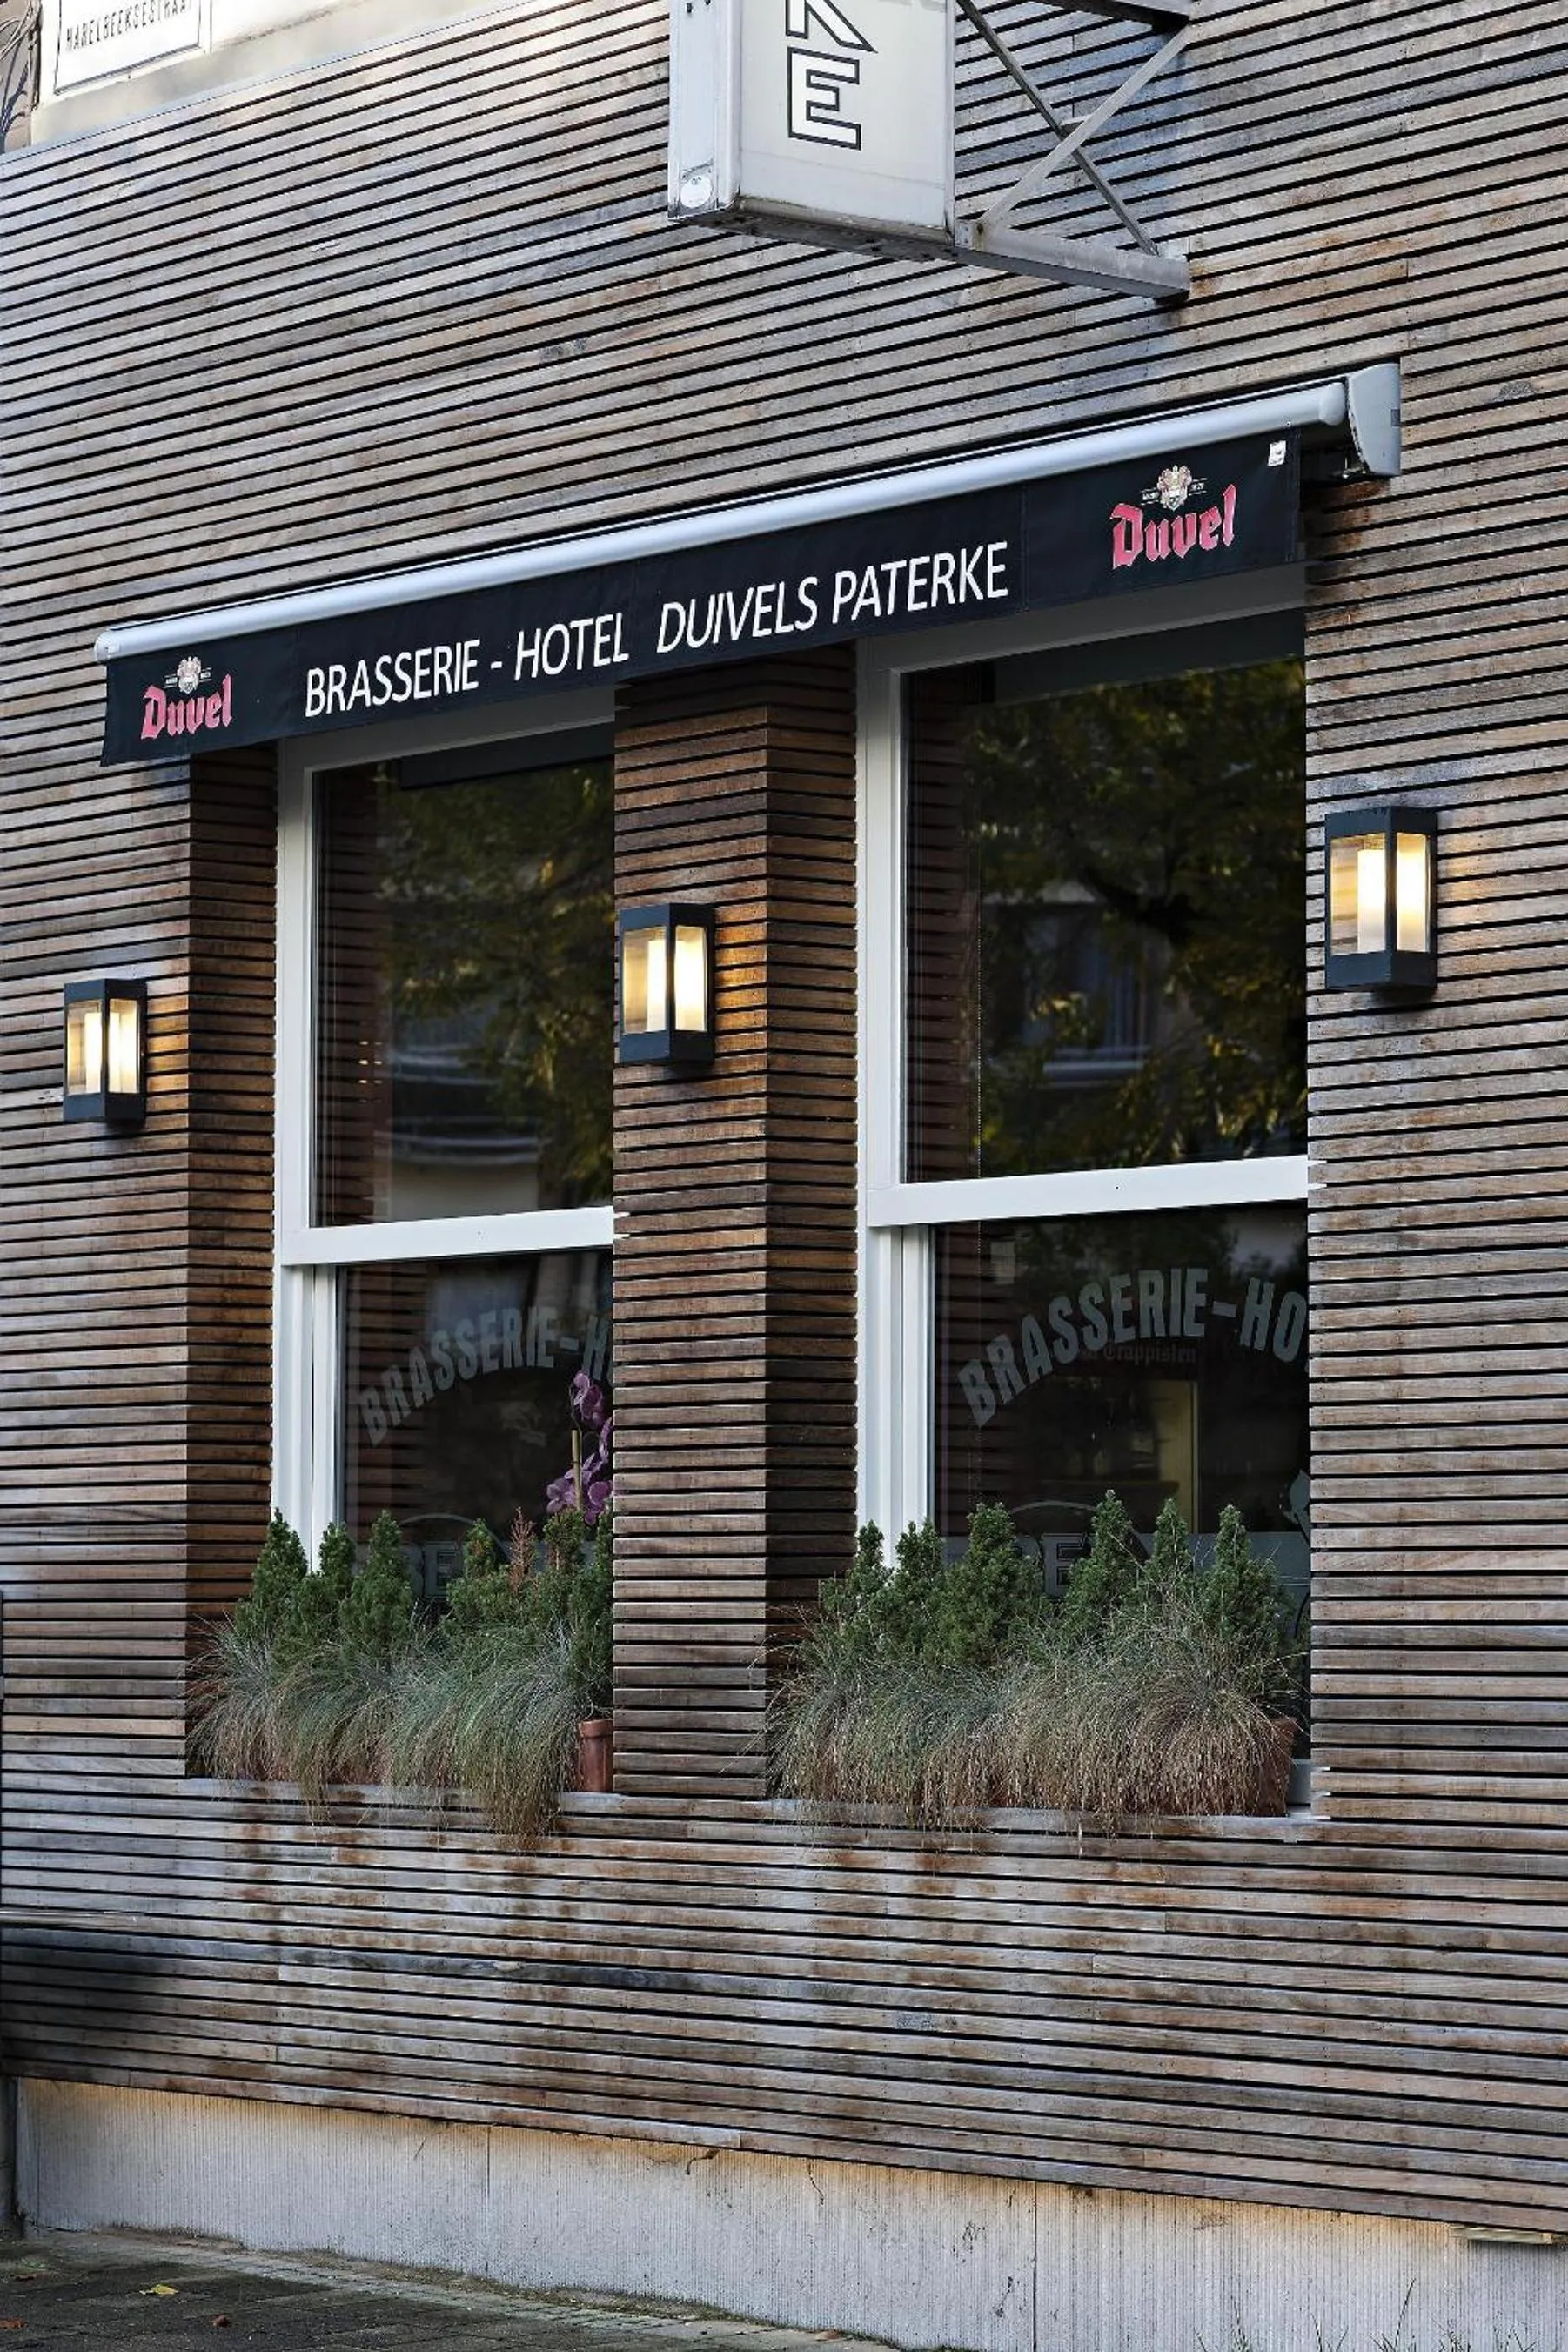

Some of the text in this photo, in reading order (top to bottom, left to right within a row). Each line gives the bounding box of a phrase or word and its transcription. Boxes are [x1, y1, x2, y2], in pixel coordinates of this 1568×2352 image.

[1111, 484, 1236, 570] Duvel
[305, 639, 482, 718] BRASSERIE
[513, 612, 630, 681] HOTEL
[656, 575, 819, 654] DUIVELS
[832, 539, 1010, 625] PATERKE
[139, 673, 233, 741] Duvel
